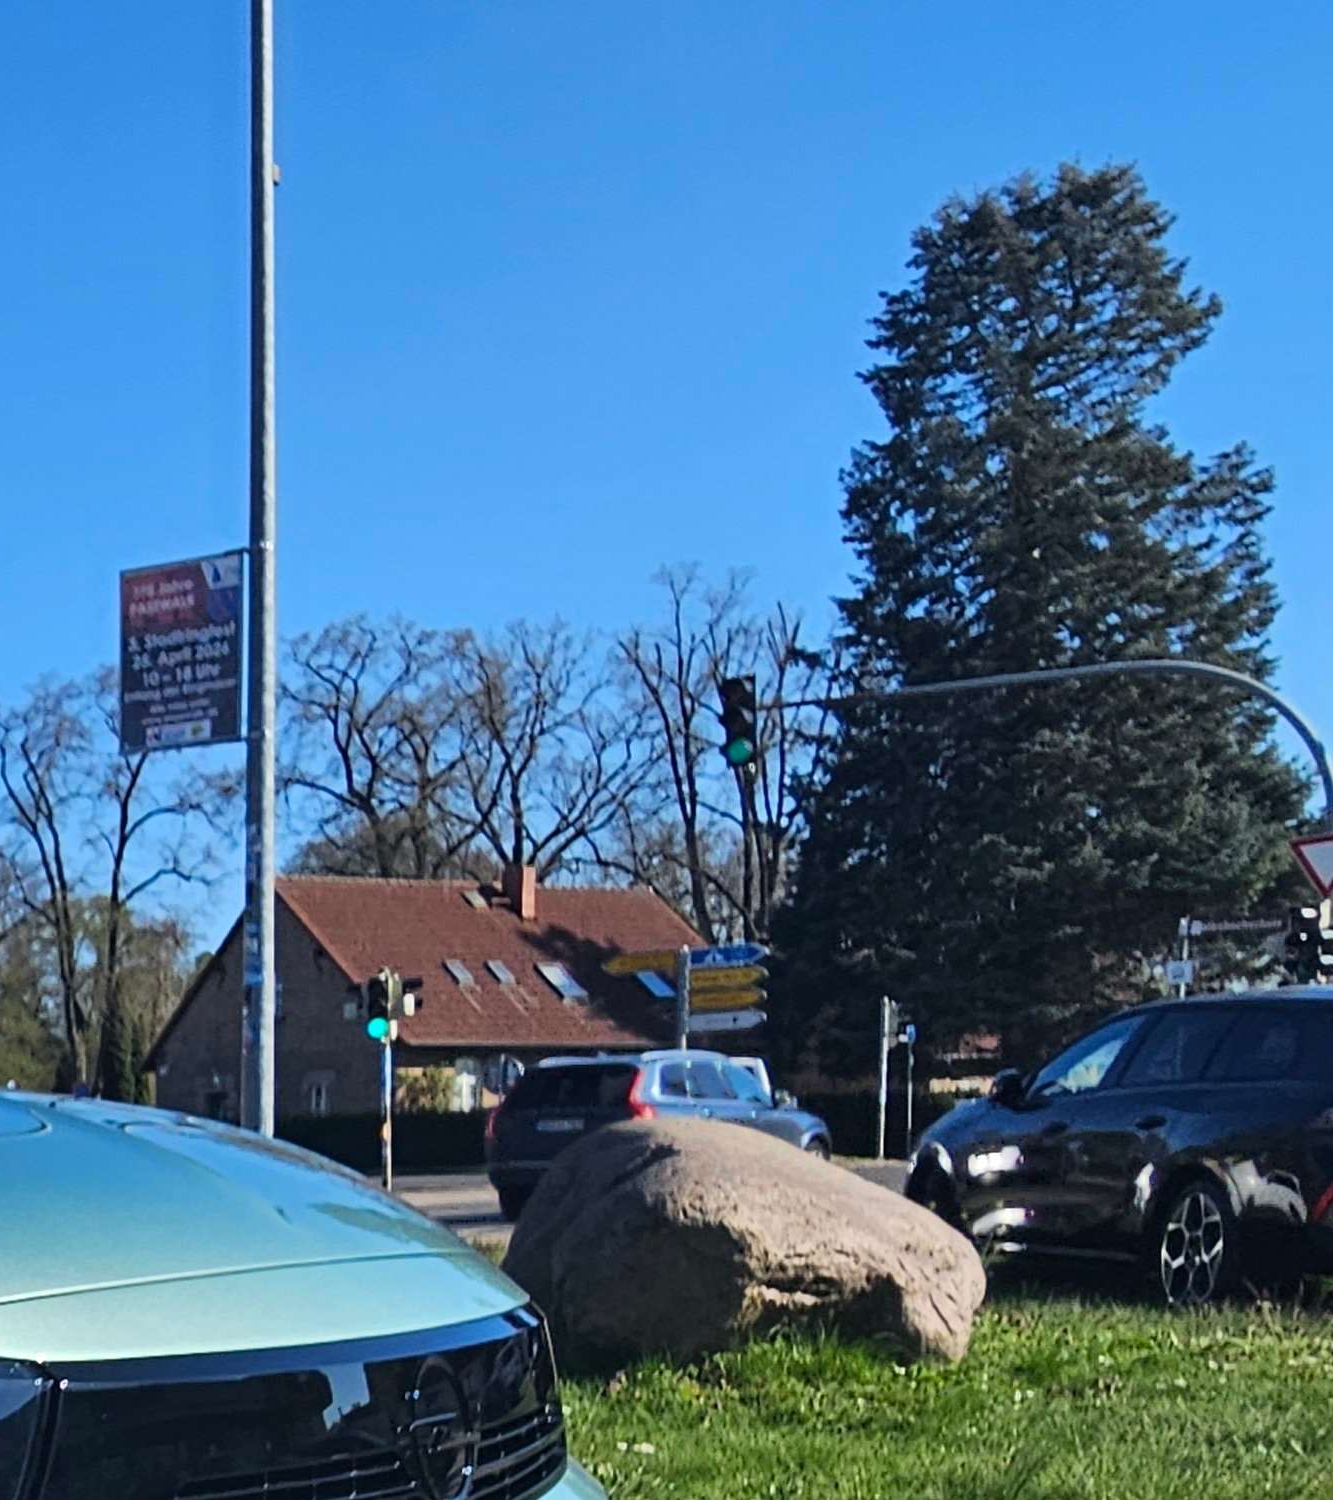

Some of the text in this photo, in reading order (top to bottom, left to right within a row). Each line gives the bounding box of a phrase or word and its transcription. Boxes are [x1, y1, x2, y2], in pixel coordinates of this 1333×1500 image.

[157, 646, 191, 667] April
[143, 671, 160, 688] 10
[196, 663, 220, 680] Uhr
